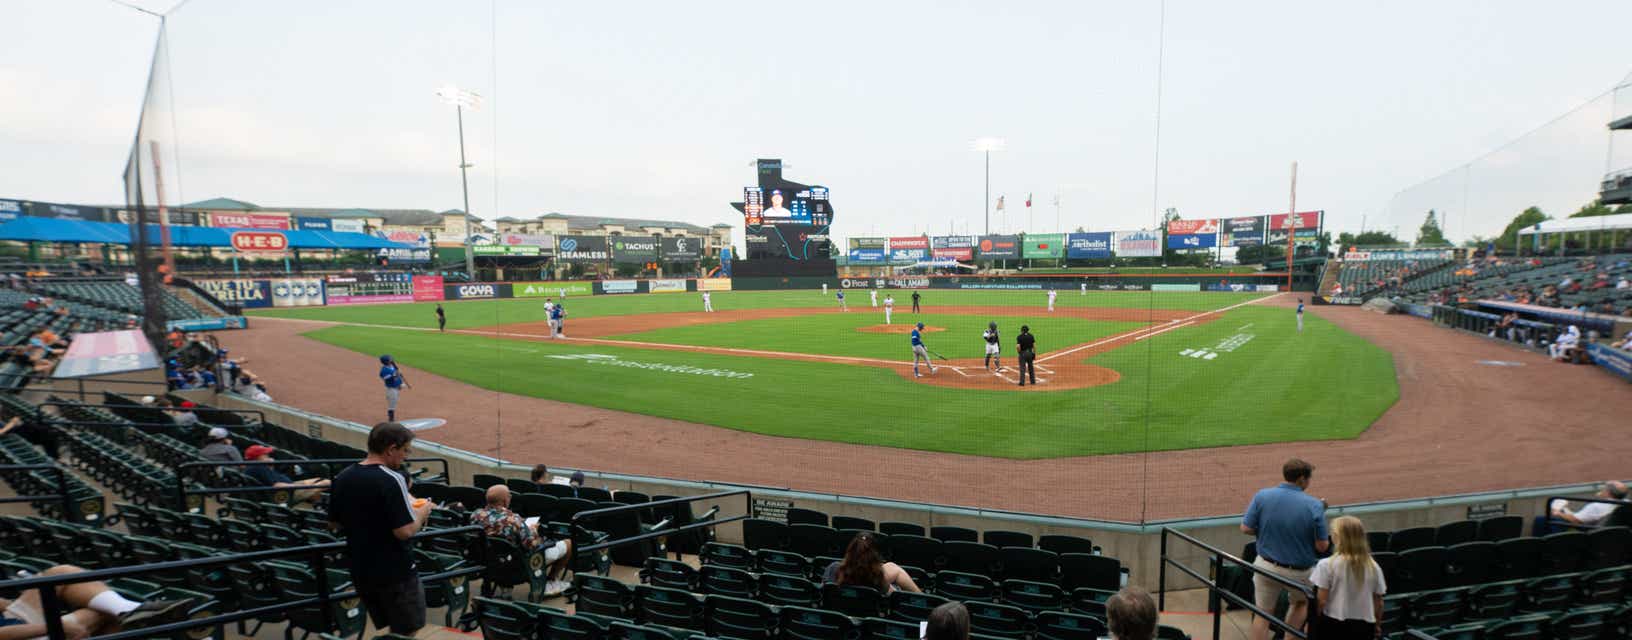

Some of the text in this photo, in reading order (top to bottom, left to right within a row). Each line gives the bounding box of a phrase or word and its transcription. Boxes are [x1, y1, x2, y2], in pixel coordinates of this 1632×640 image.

[625, 243, 655, 251] TACHUS
[561, 251, 607, 259] SEAMLESS
[460, 285, 495, 295] GOYA
